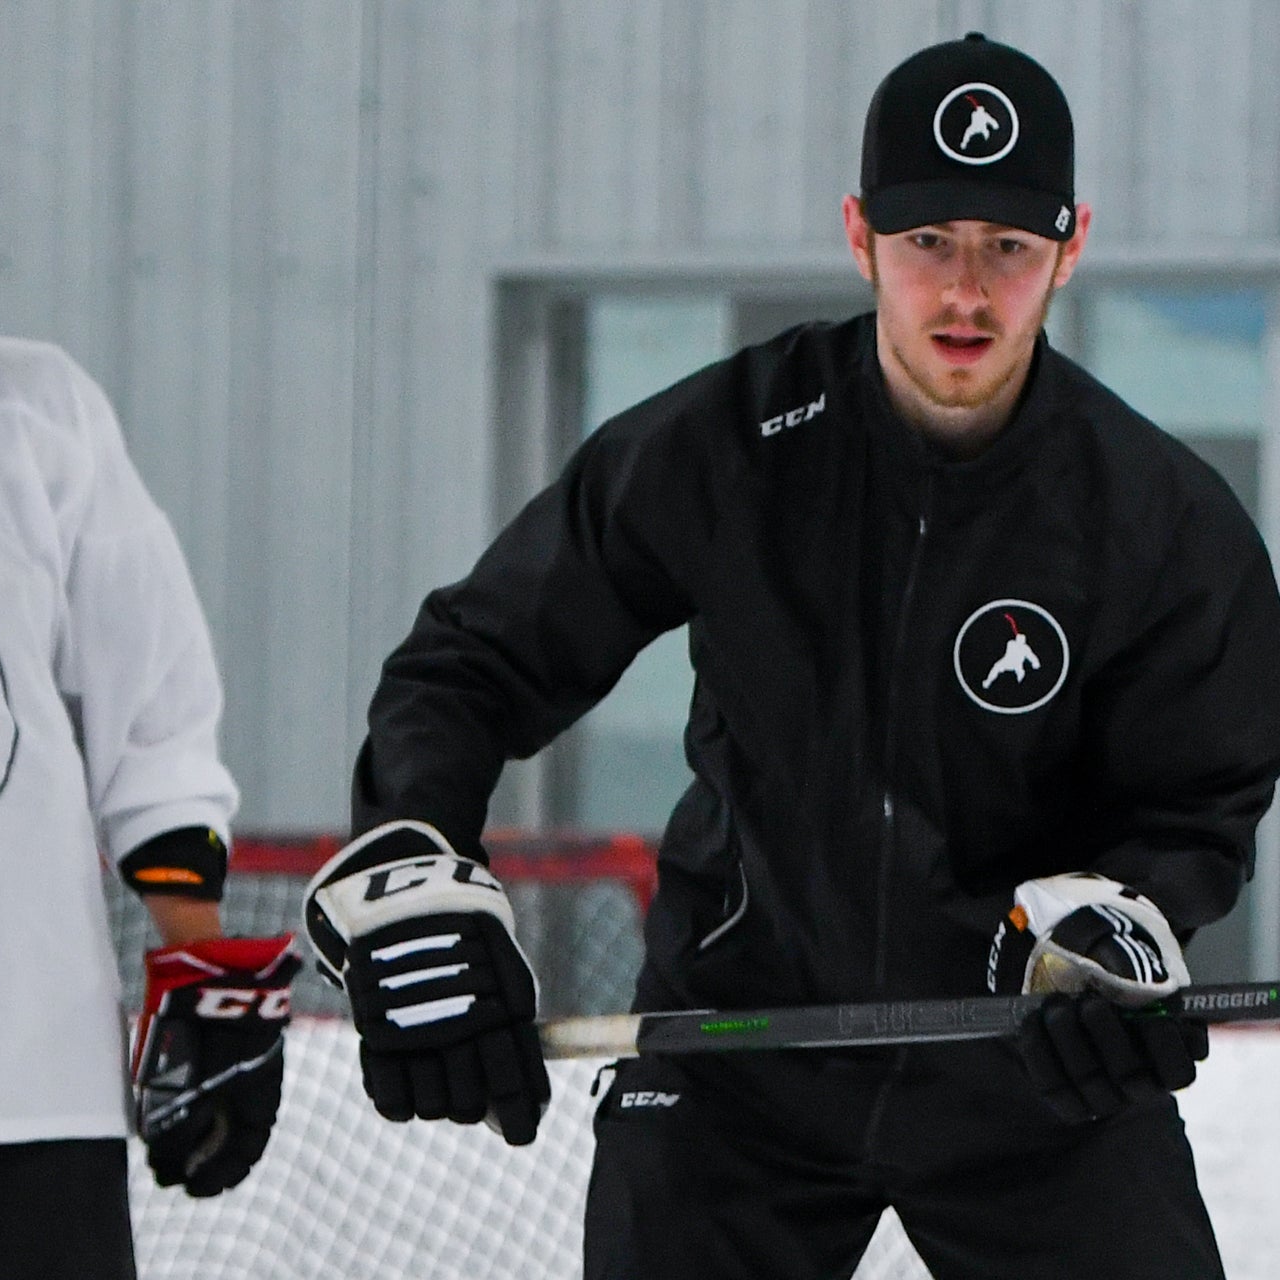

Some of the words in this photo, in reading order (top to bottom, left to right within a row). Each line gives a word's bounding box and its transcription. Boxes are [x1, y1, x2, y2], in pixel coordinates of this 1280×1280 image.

[760, 392, 826, 437] CCM
[363, 859, 501, 902] CC
[986, 920, 1007, 994] CCM
[195, 987, 291, 1020] CC
[620, 1090, 681, 1109] CCM
